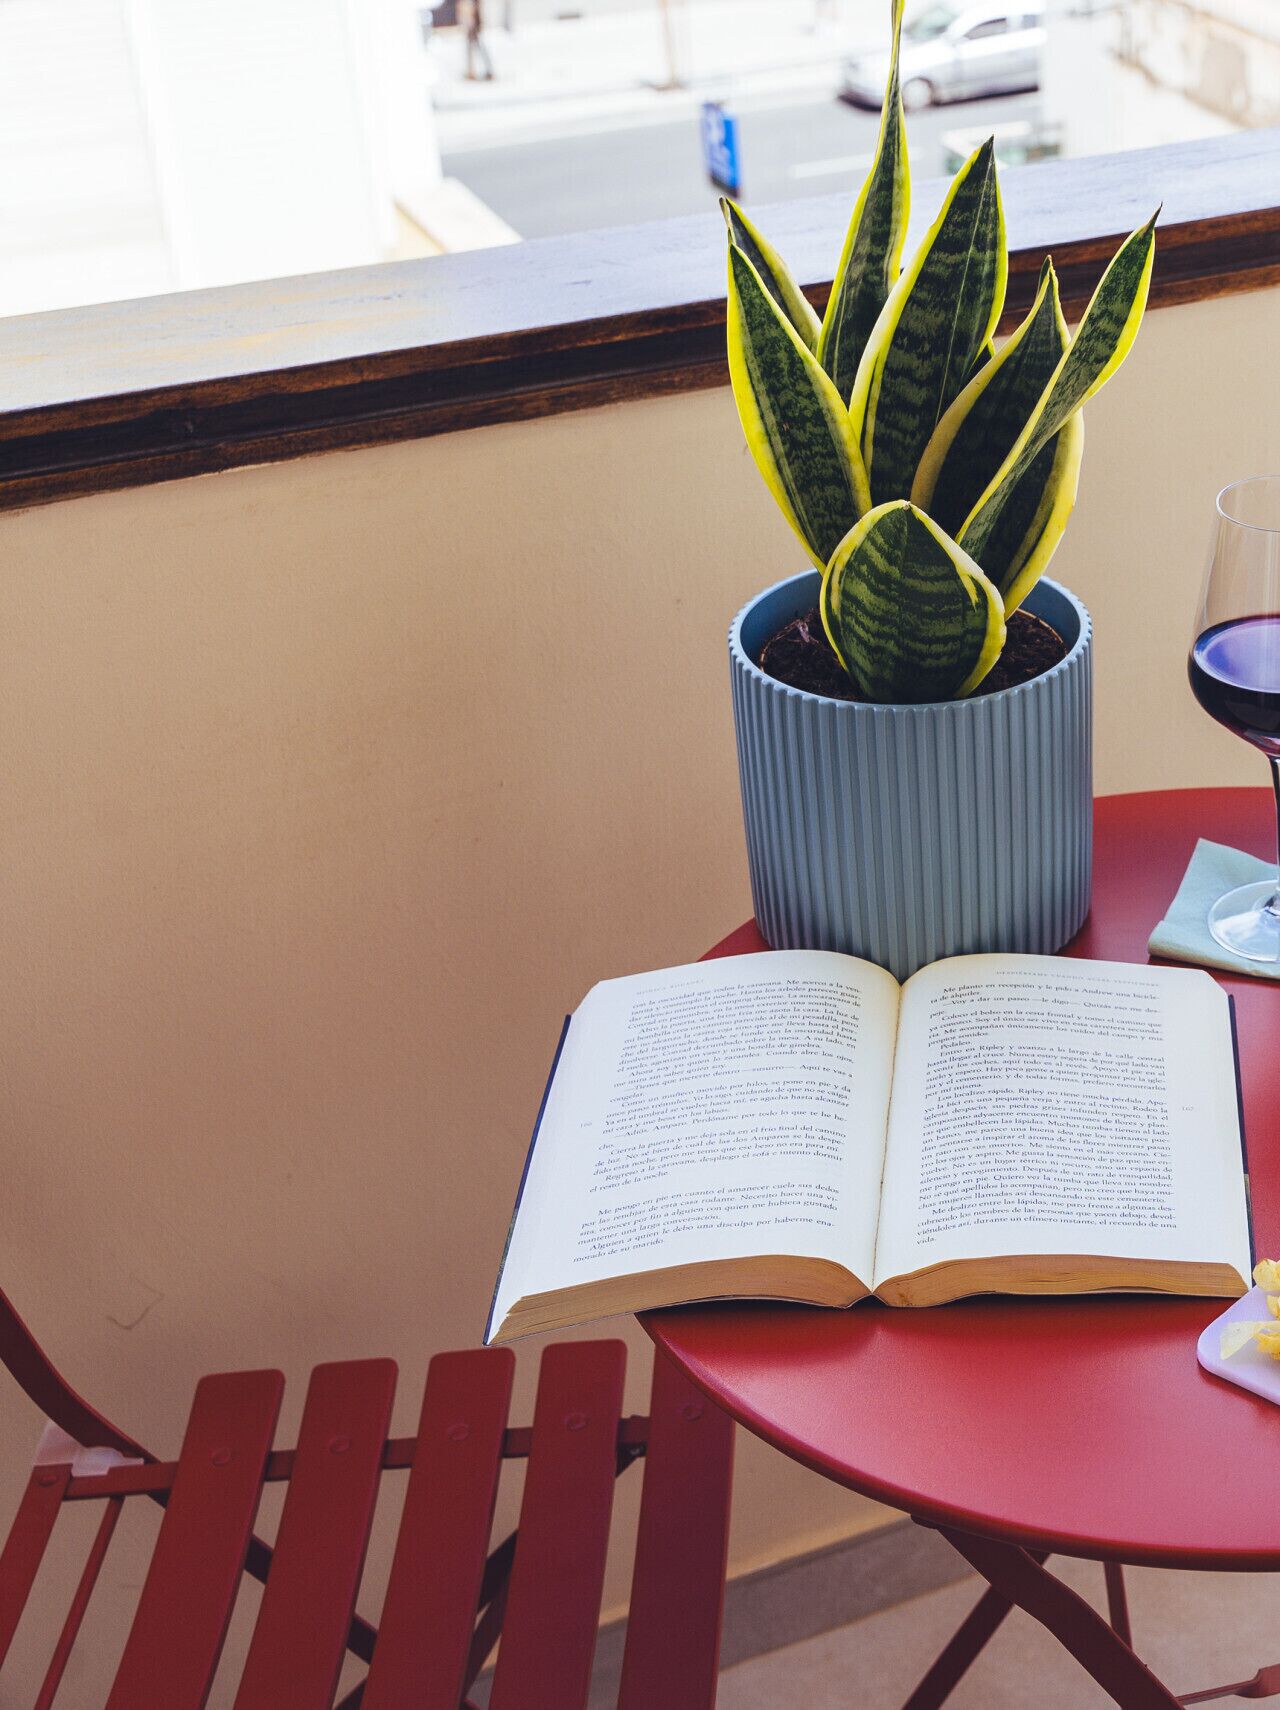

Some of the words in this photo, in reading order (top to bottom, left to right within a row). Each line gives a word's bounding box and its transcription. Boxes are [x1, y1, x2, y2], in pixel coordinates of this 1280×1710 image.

[958, 983, 983, 991] planto
[1047, 1010, 1074, 1018] frontal
[940, 1049, 963, 1057] Entro
[1068, 1048, 1090, 1056] largo
[954, 1090, 986, 1098] localizo
[1018, 1088, 1045, 1096] Ripley
[605, 1169, 638, 1180] Regreso
[699, 1154, 740, 1162] despliego
[813, 1150, 843, 1160] dormir
[615, 1203, 640, 1213] pongo
[656, 1196, 669, 1204] pie
[815, 1184, 839, 1193] dedos
[741, 1192, 777, 1200] Necesito
[948, 1203, 977, 1212] deslizo
[599, 1221, 631, 1232] conocer
[634, 1218, 647, 1226] por
[671, 1207, 704, 1216] alguien
[724, 1204, 749, 1212] quien
[803, 1201, 838, 1210] gustado
[918, 1215, 958, 1226] cubriendo
[578, 1233, 618, 1245] mantener
[640, 1222, 660, 1231] larga
[590, 1239, 625, 1250] Alguien
[635, 1232, 659, 1241] quien
[573, 1251, 606, 1262] morado
